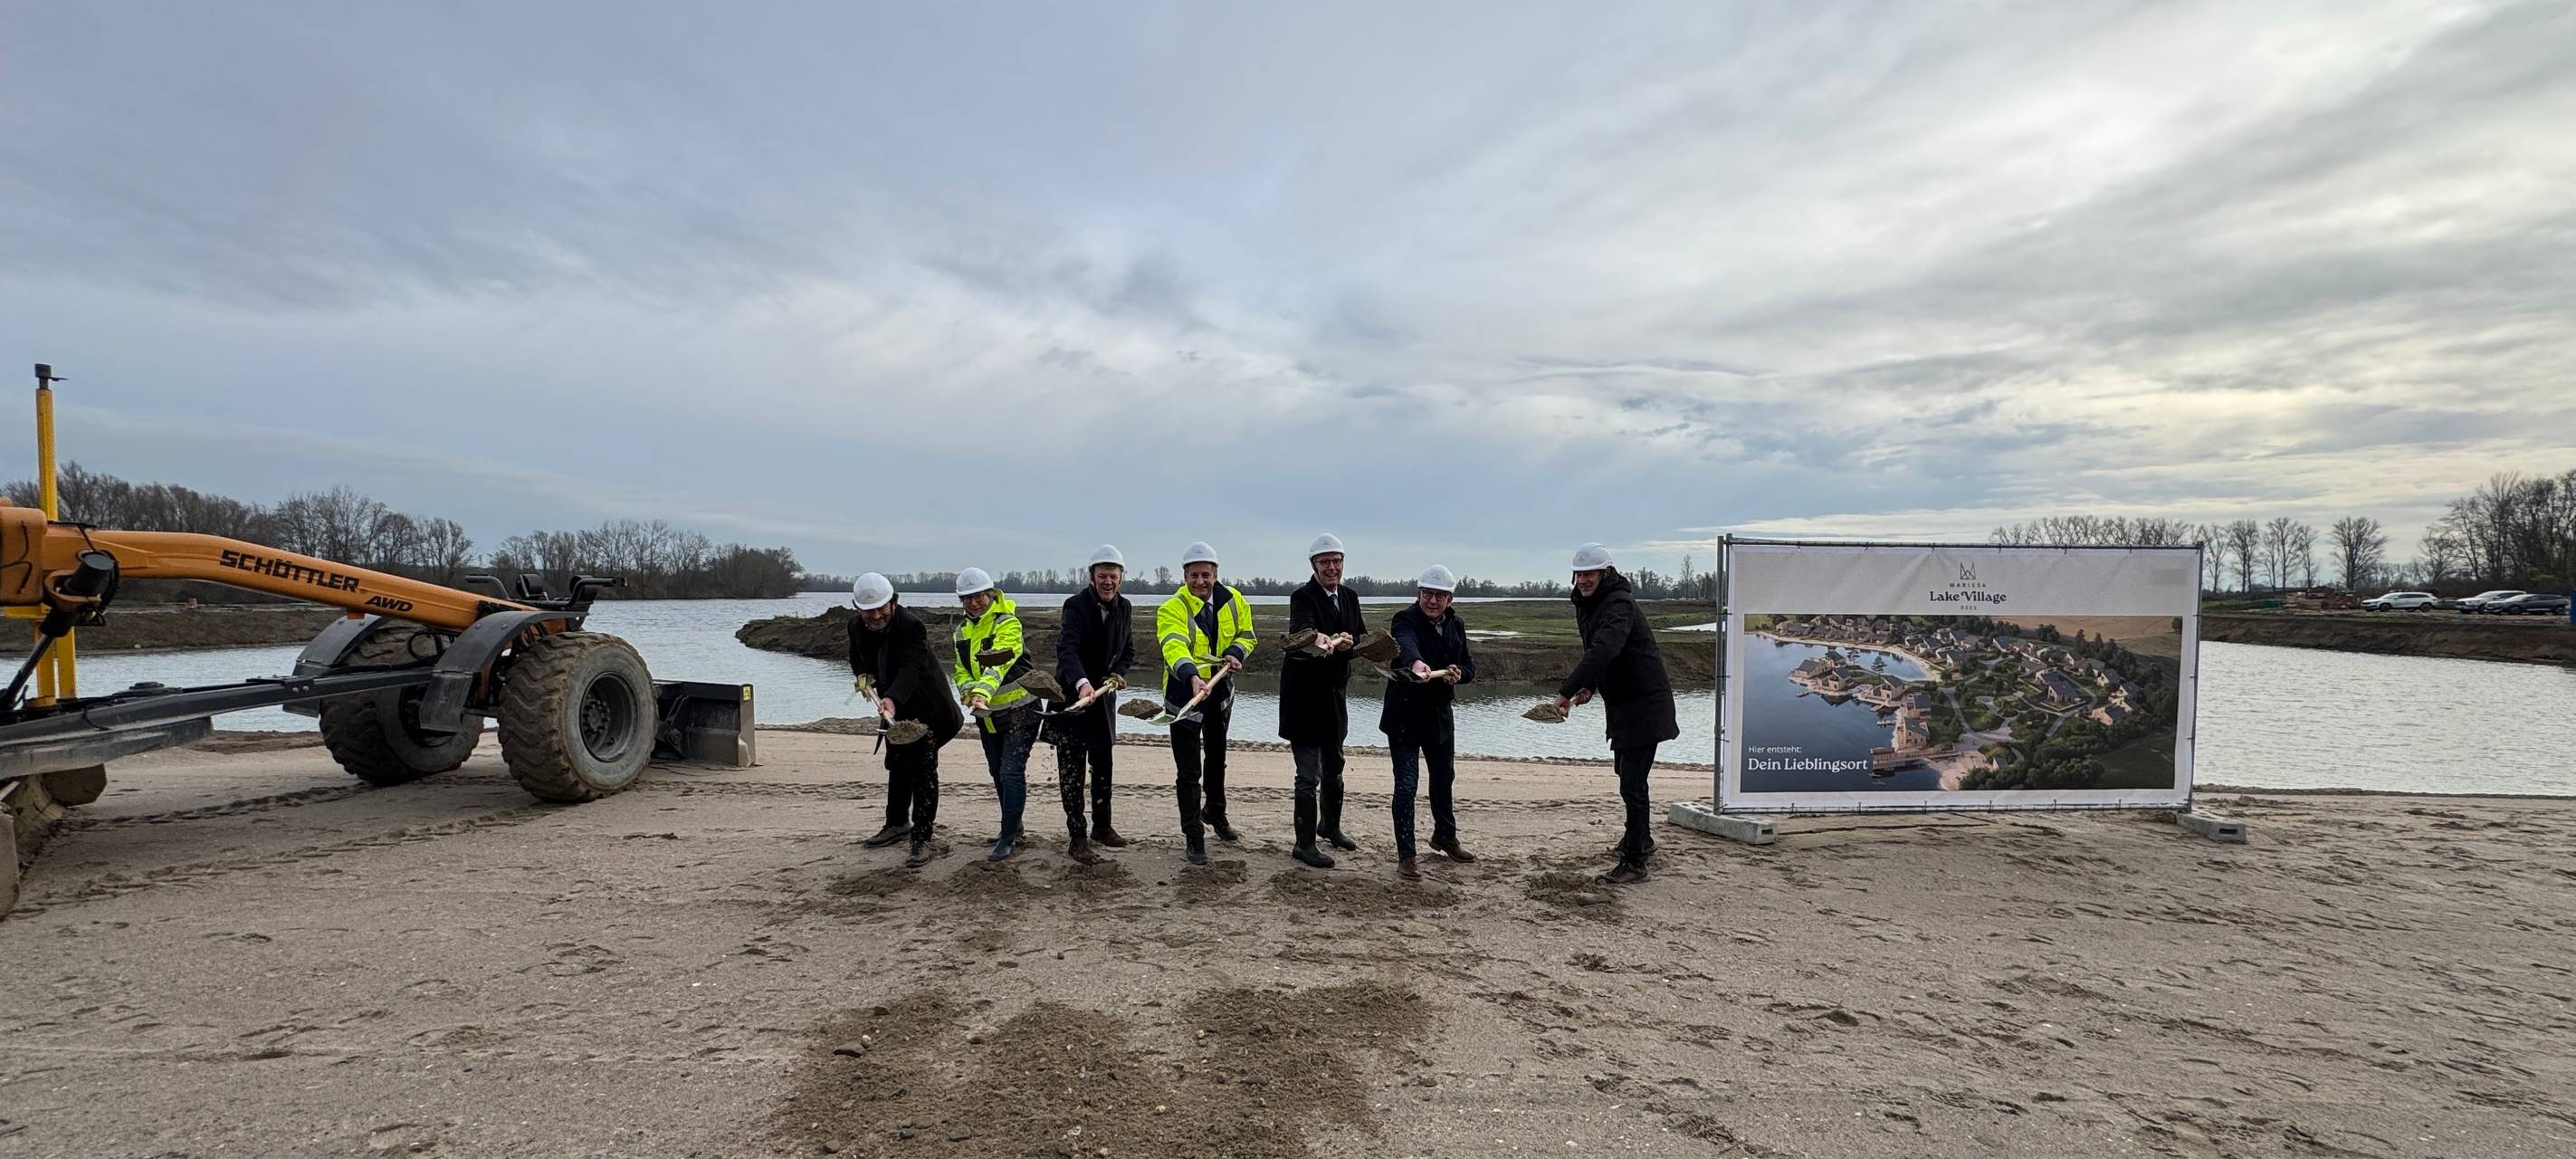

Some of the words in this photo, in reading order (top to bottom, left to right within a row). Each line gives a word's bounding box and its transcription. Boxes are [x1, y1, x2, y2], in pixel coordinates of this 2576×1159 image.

[220, 550, 359, 593] SCHÖTTLER
[365, 594, 414, 613] AWD
[1930, 590, 1961, 602] Lake
[1961, 590, 2007, 605] Village
[1748, 745, 1765, 753] Hier
[1766, 745, 1802, 753] entsteht:
[1748, 758, 1781, 771] Dein
[1784, 758, 1868, 773] Lieblingsort
